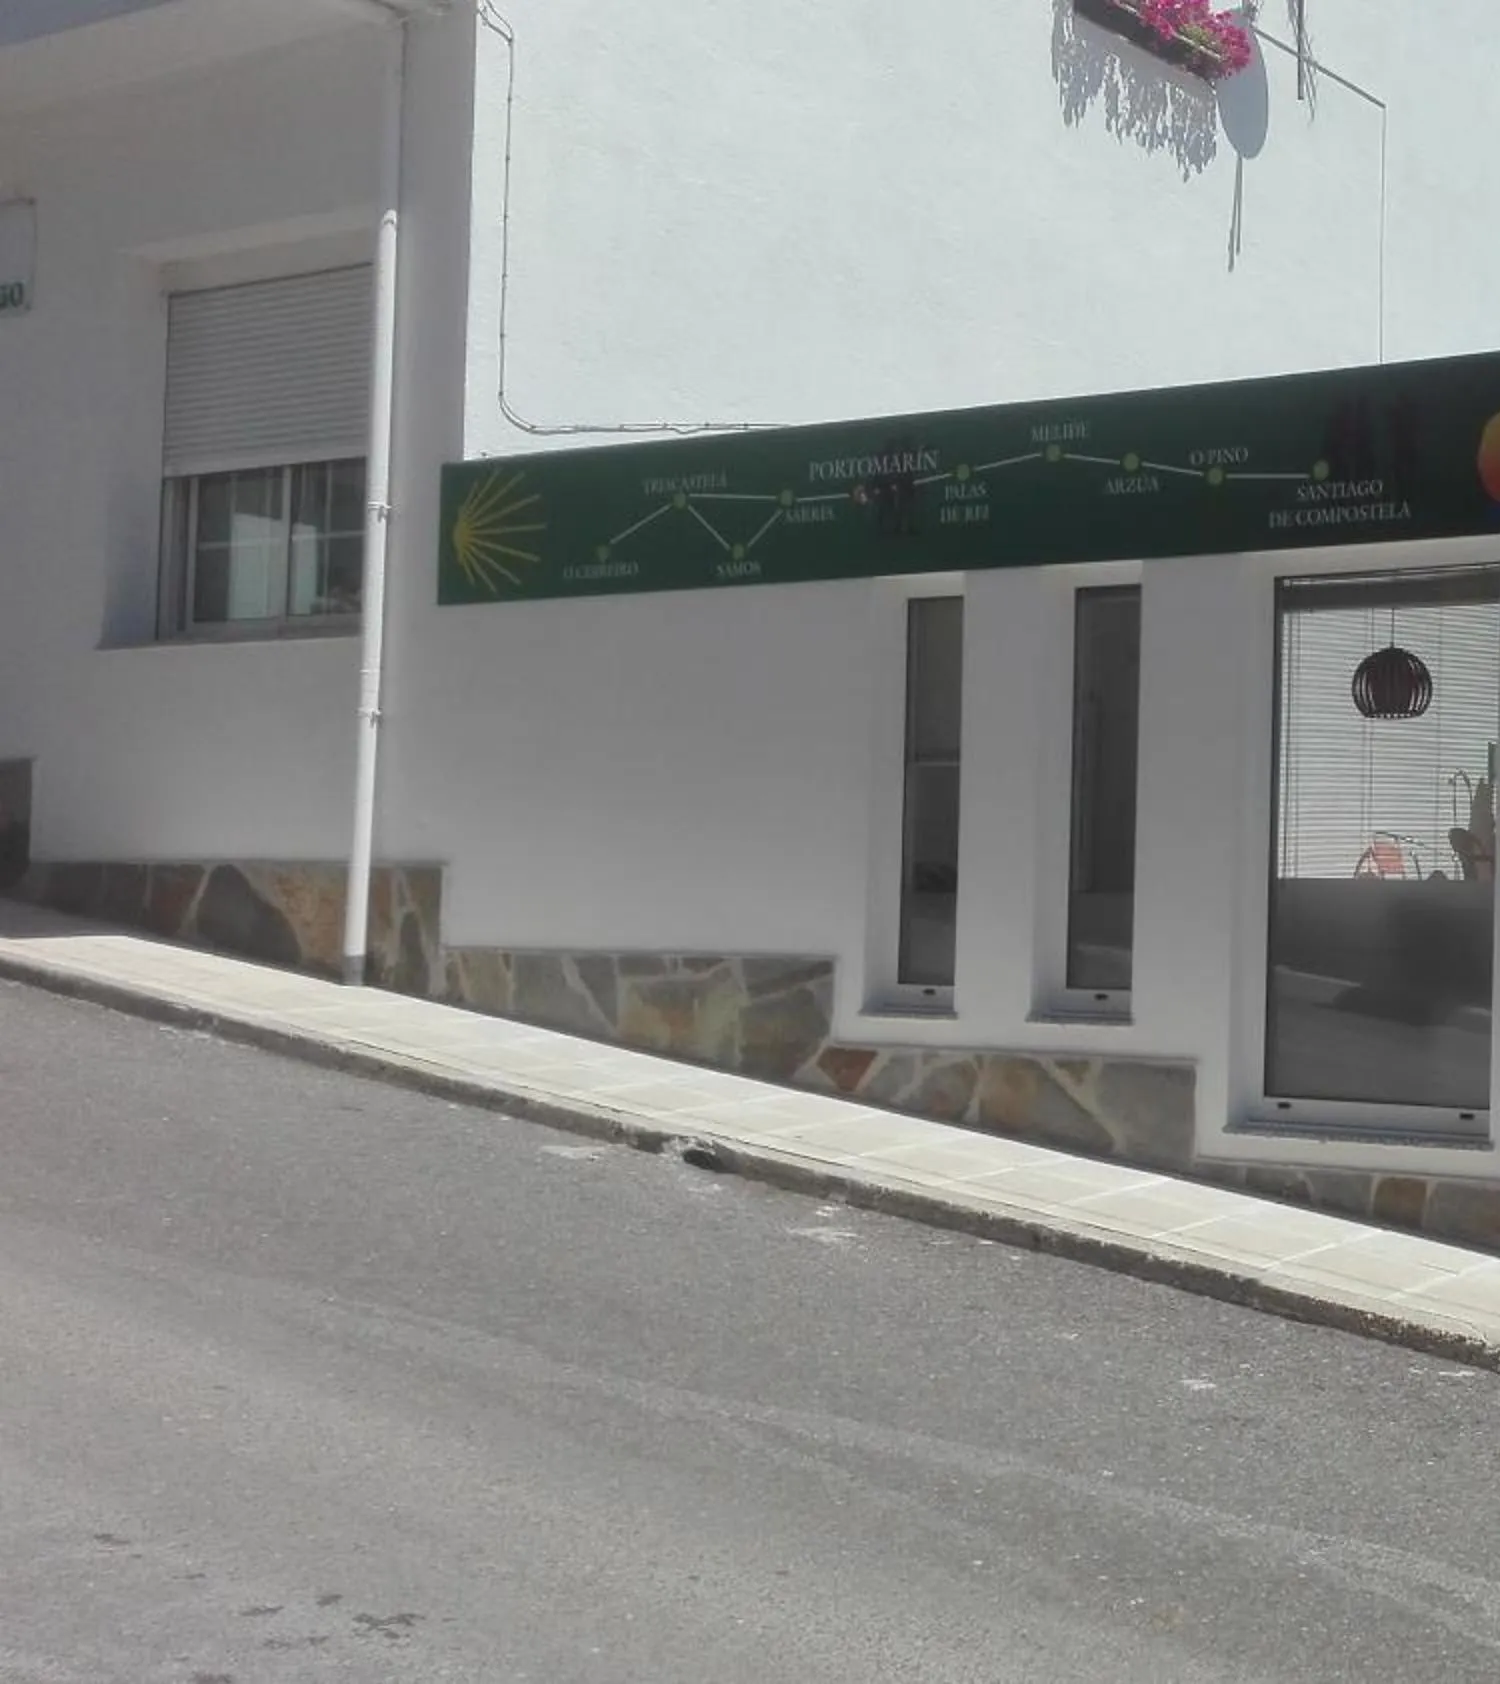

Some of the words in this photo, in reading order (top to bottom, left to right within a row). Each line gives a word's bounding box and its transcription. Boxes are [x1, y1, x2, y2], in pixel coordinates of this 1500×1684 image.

[808, 446, 939, 481] PORTOMARÍN
[1190, 451, 1202, 465] O
[1206, 446, 1249, 465] PINO
[945, 482, 988, 501] PALAS
[1296, 479, 1383, 500] SANTIAGO
[940, 506, 960, 524] DE
[1269, 510, 1294, 529] DE
[1295, 502, 1412, 527] COMPOSTELA
